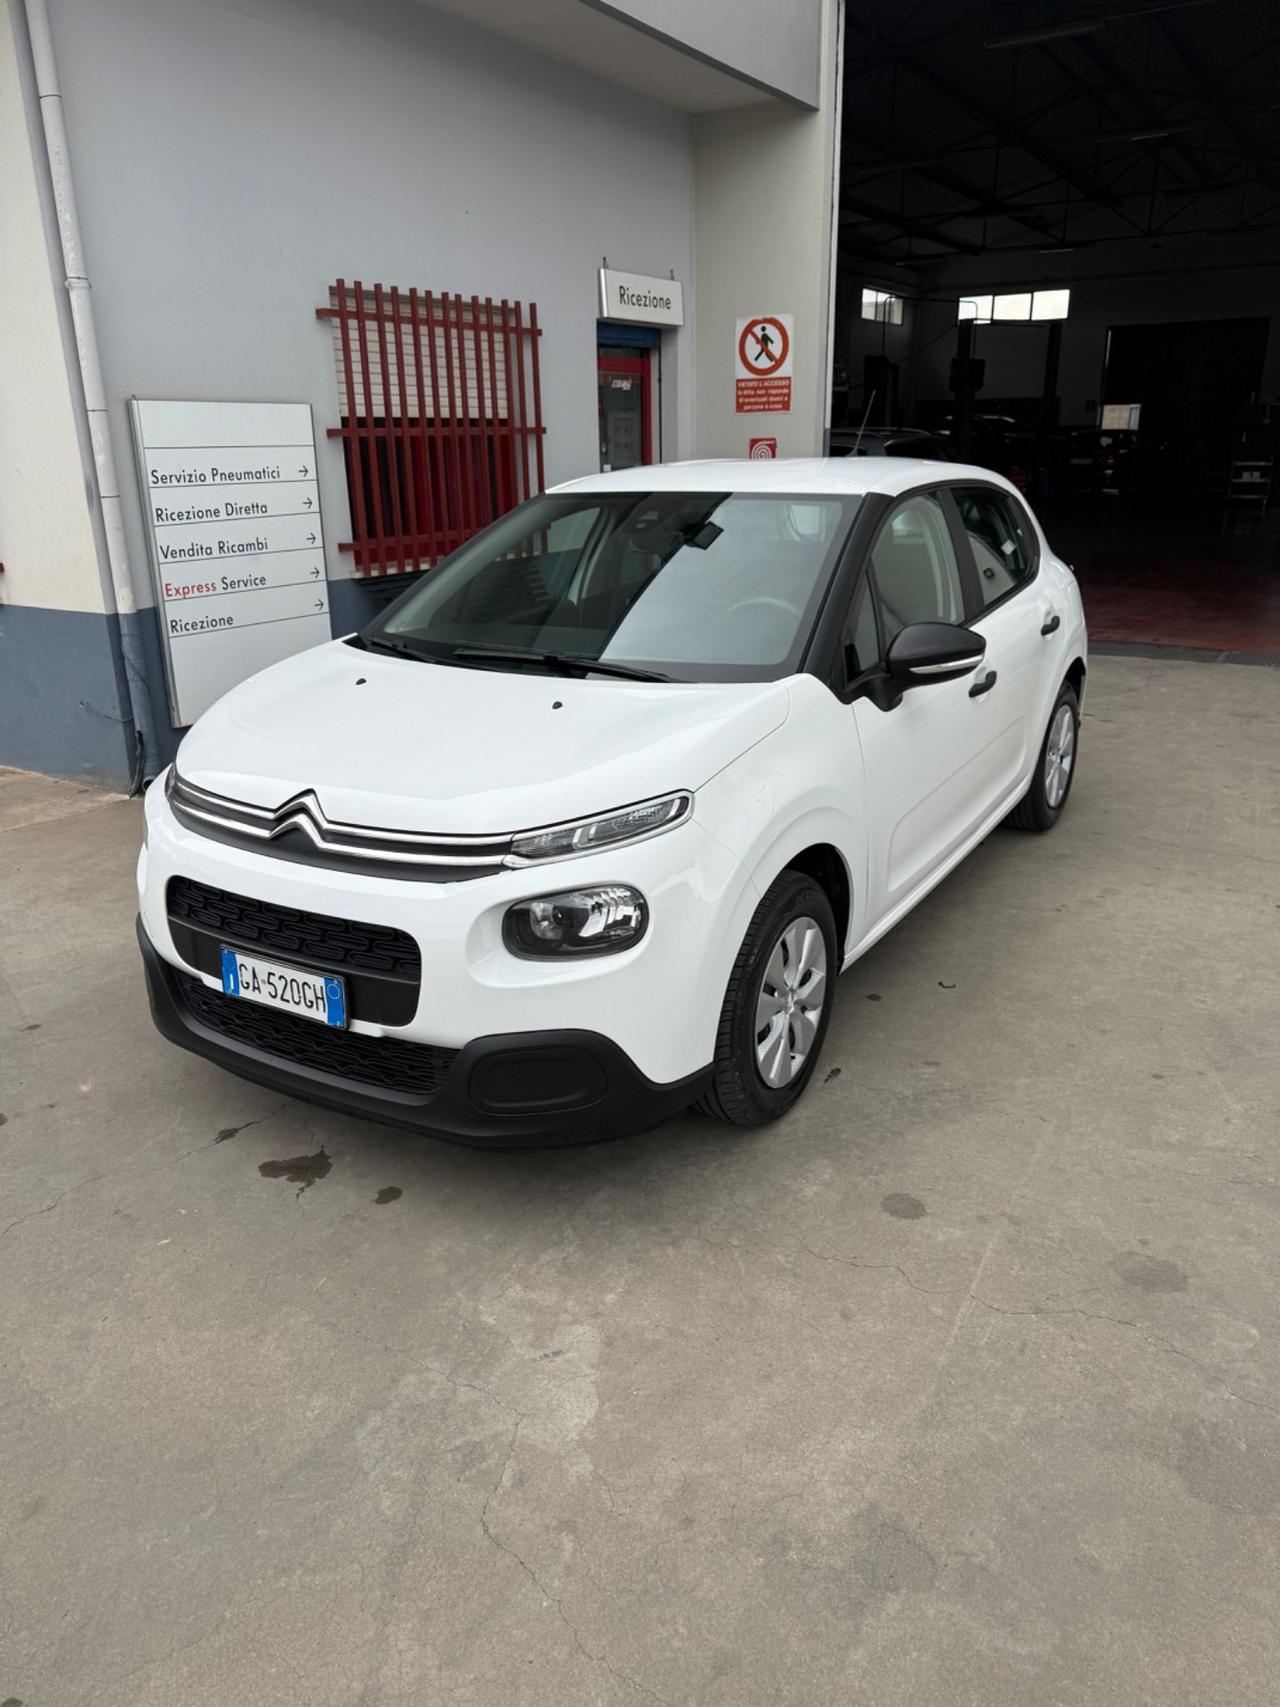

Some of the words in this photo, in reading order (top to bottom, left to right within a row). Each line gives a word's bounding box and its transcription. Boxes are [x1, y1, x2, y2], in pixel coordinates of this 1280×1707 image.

[619, 285, 672, 310] Ricezione
[150, 468, 207, 485] Servizio
[210, 466, 280, 482] Pneumatici
[155, 505, 221, 523] Ricezione
[224, 502, 268, 518] Diretta
[159, 543, 213, 560] Vendita
[217, 537, 268, 555] Ricambi
[164, 582, 217, 599] Express
[221, 574, 267, 591] Service
[169, 615, 234, 633] Ricezione
